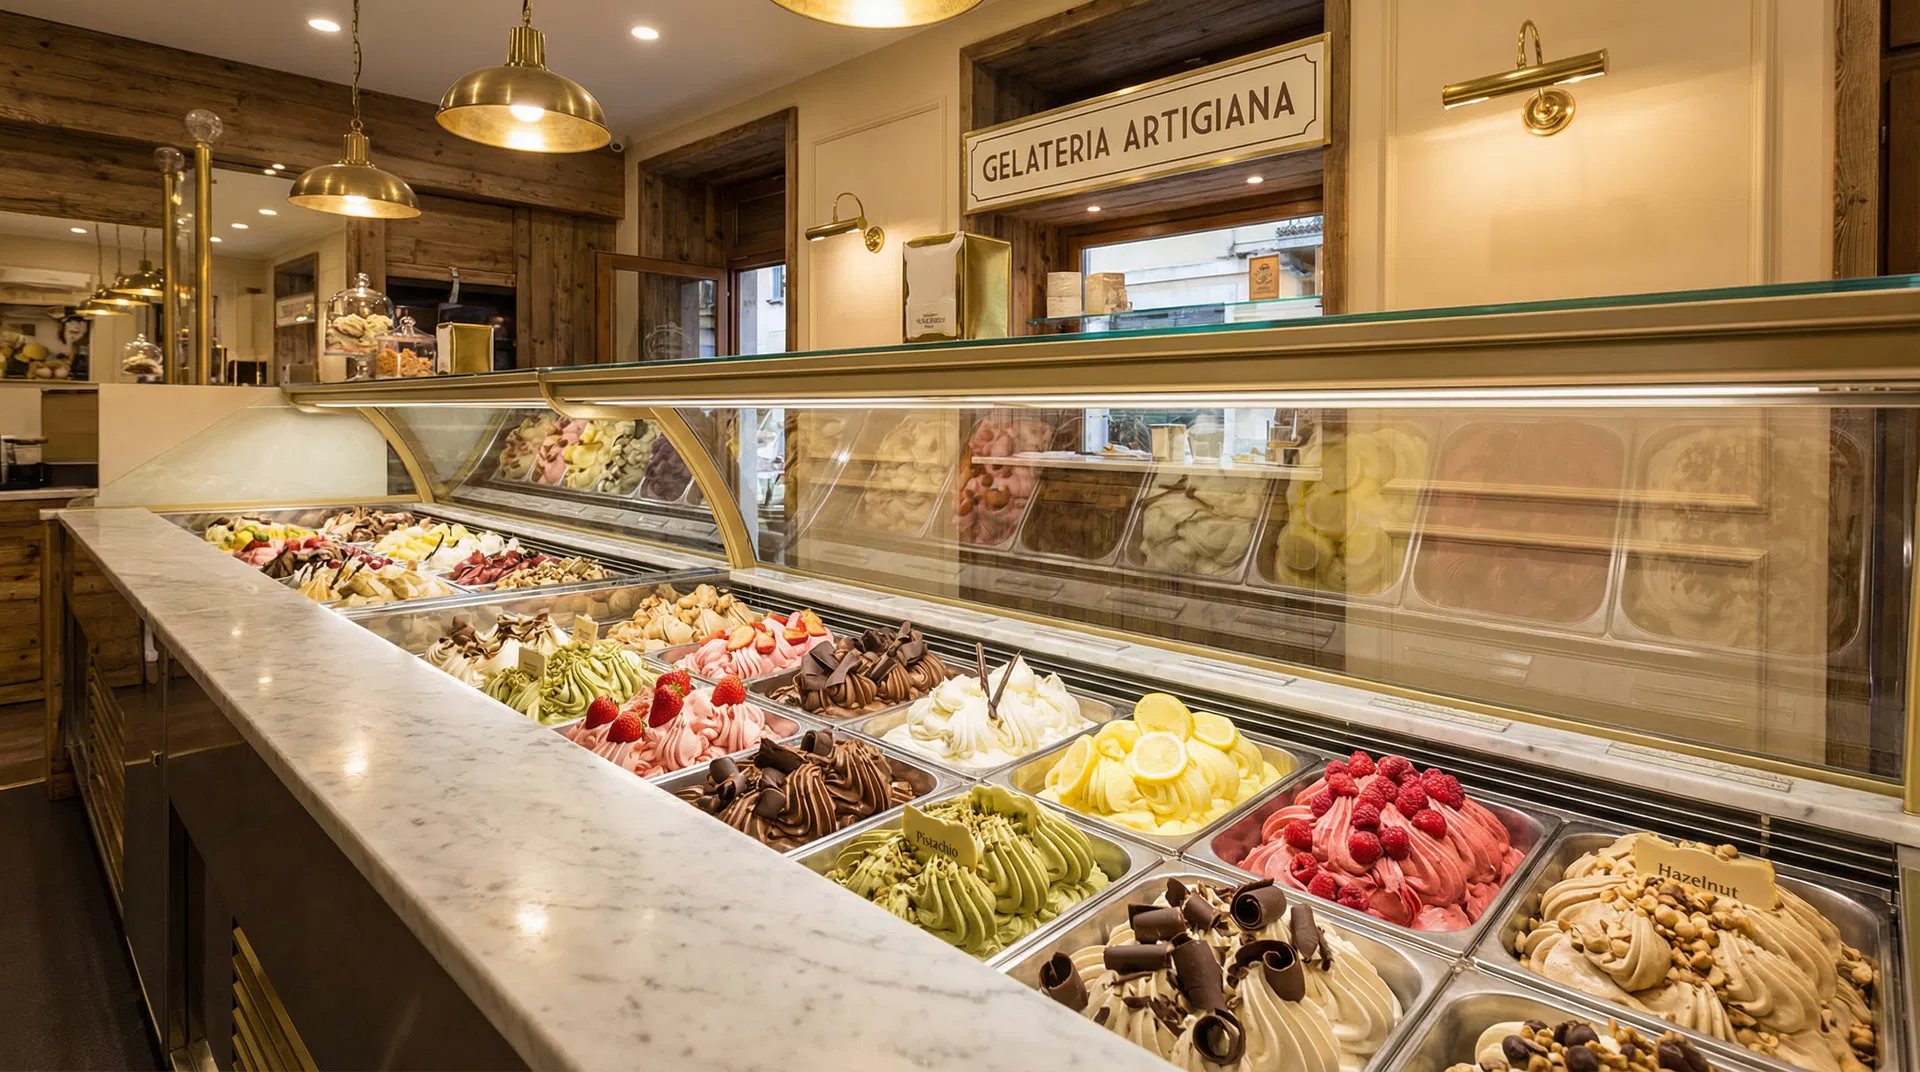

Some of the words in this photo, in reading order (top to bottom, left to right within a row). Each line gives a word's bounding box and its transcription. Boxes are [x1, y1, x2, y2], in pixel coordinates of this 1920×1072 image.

[982, 126, 1111, 183] GELATERIA
[1123, 80, 1296, 153] ARTIGIANA
[916, 830, 959, 858] Pistachio
[1658, 862, 1739, 899] Hazelnut
